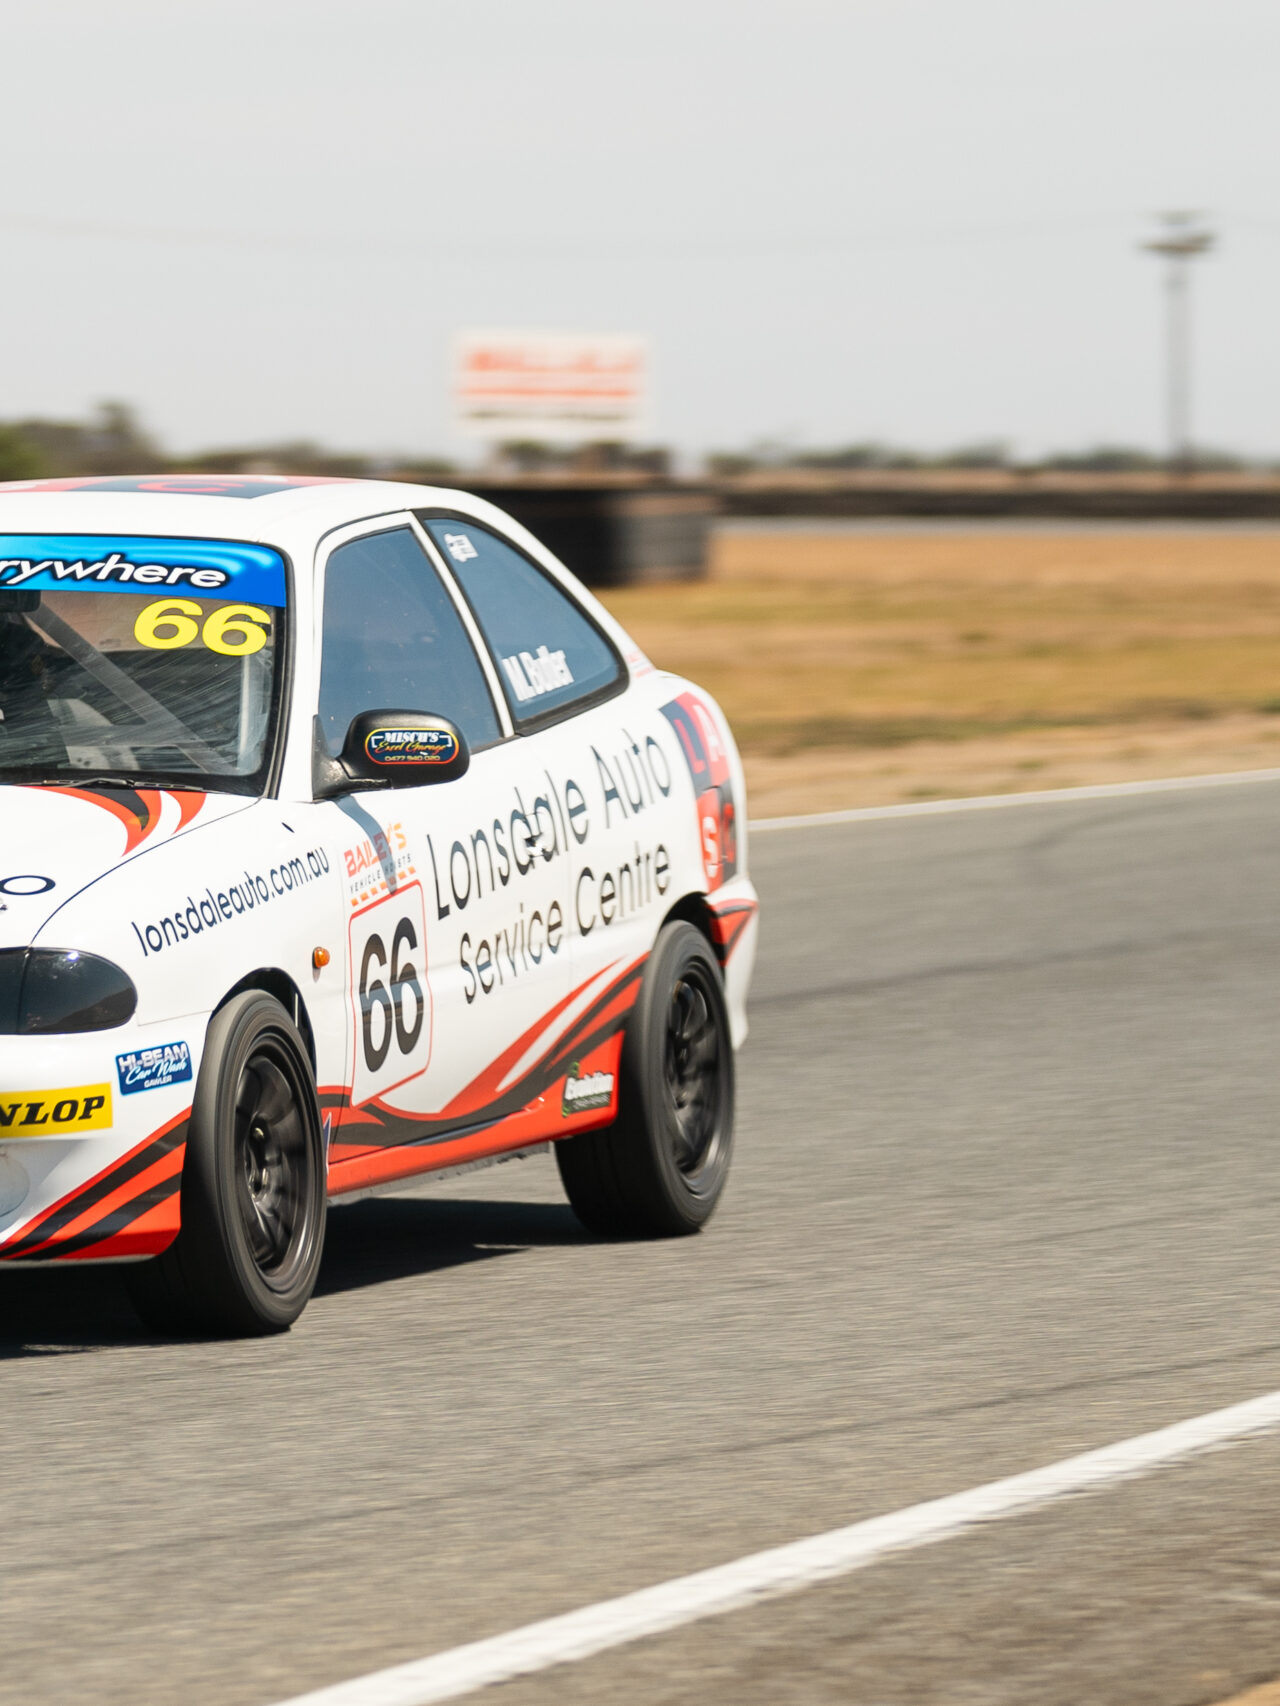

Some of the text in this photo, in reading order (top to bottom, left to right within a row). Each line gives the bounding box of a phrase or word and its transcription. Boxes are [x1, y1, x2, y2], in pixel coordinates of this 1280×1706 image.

[134, 598, 271, 656] 66
[426, 728, 672, 921] Lonsdale Auto
[131, 846, 331, 957] lonsdaleauto.com.au
[459, 840, 671, 1005] Service Centre
[359, 916, 425, 1073] 66
[118, 1043, 189, 1073] HI-BEAM
[125, 1057, 188, 1085] Car Wash
